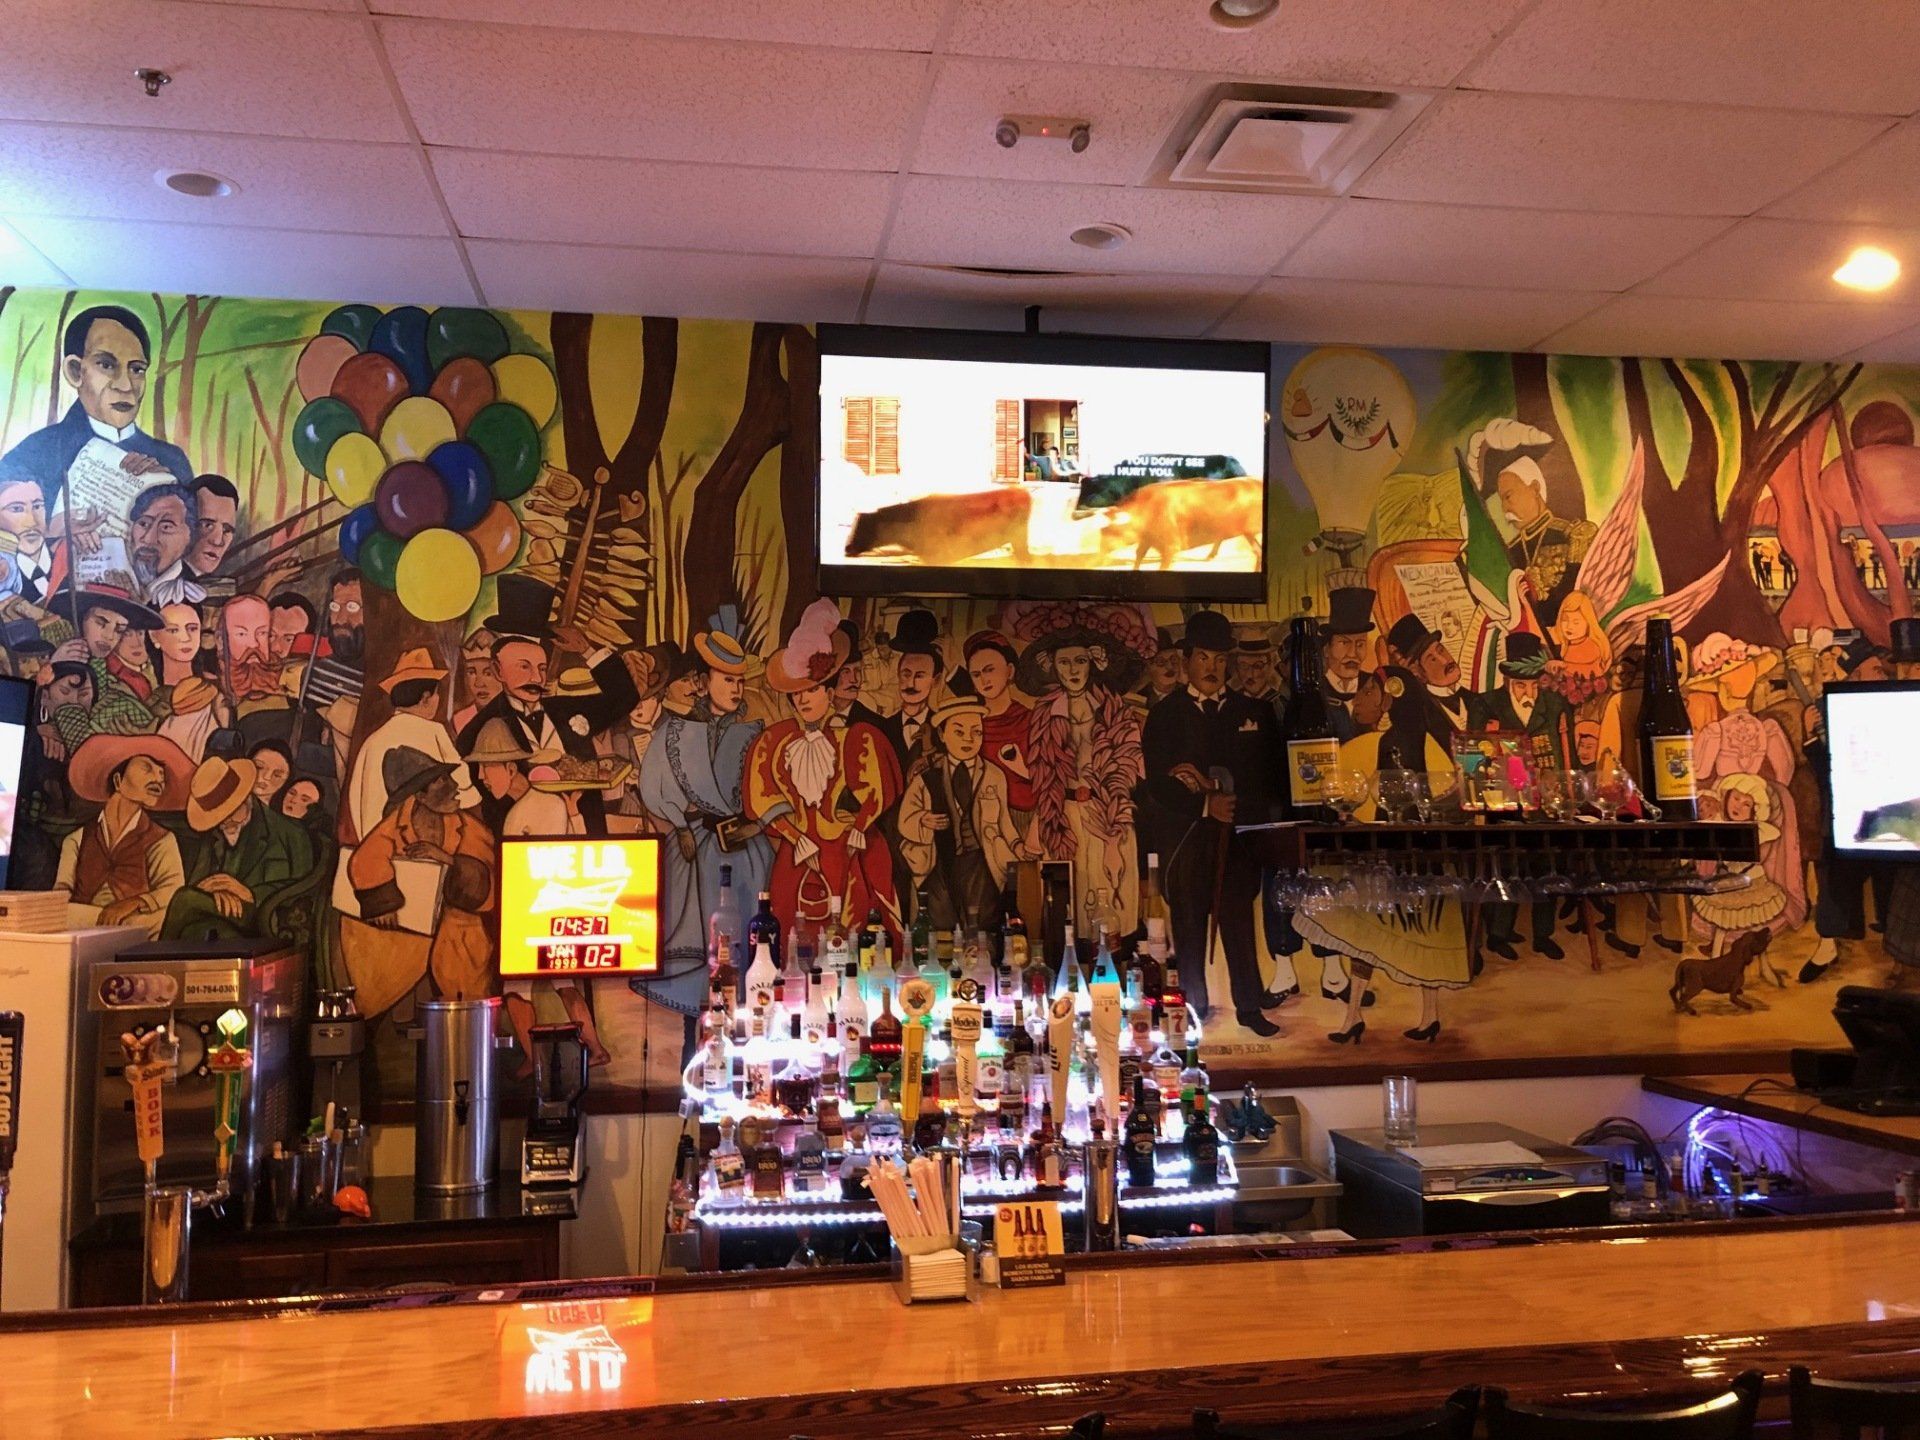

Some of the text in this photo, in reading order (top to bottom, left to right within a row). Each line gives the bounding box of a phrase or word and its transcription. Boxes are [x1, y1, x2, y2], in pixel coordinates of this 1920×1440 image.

[1117, 466, 1146, 476] HURT
[1148, 467, 1175, 477] YOU.
[1150, 457, 1183, 466] DON'T
[1185, 458, 1205, 467] SEE
[527, 846, 577, 879] WE
[552, 917, 608, 936] 04:37
[749, 933, 777, 945] SY
[546, 945, 616, 967] JAN 02
[1172, 1013, 1184, 1033] 7
[0, 1095, 11, 1137] BUD
[147, 1087, 161, 1137] BOCK
